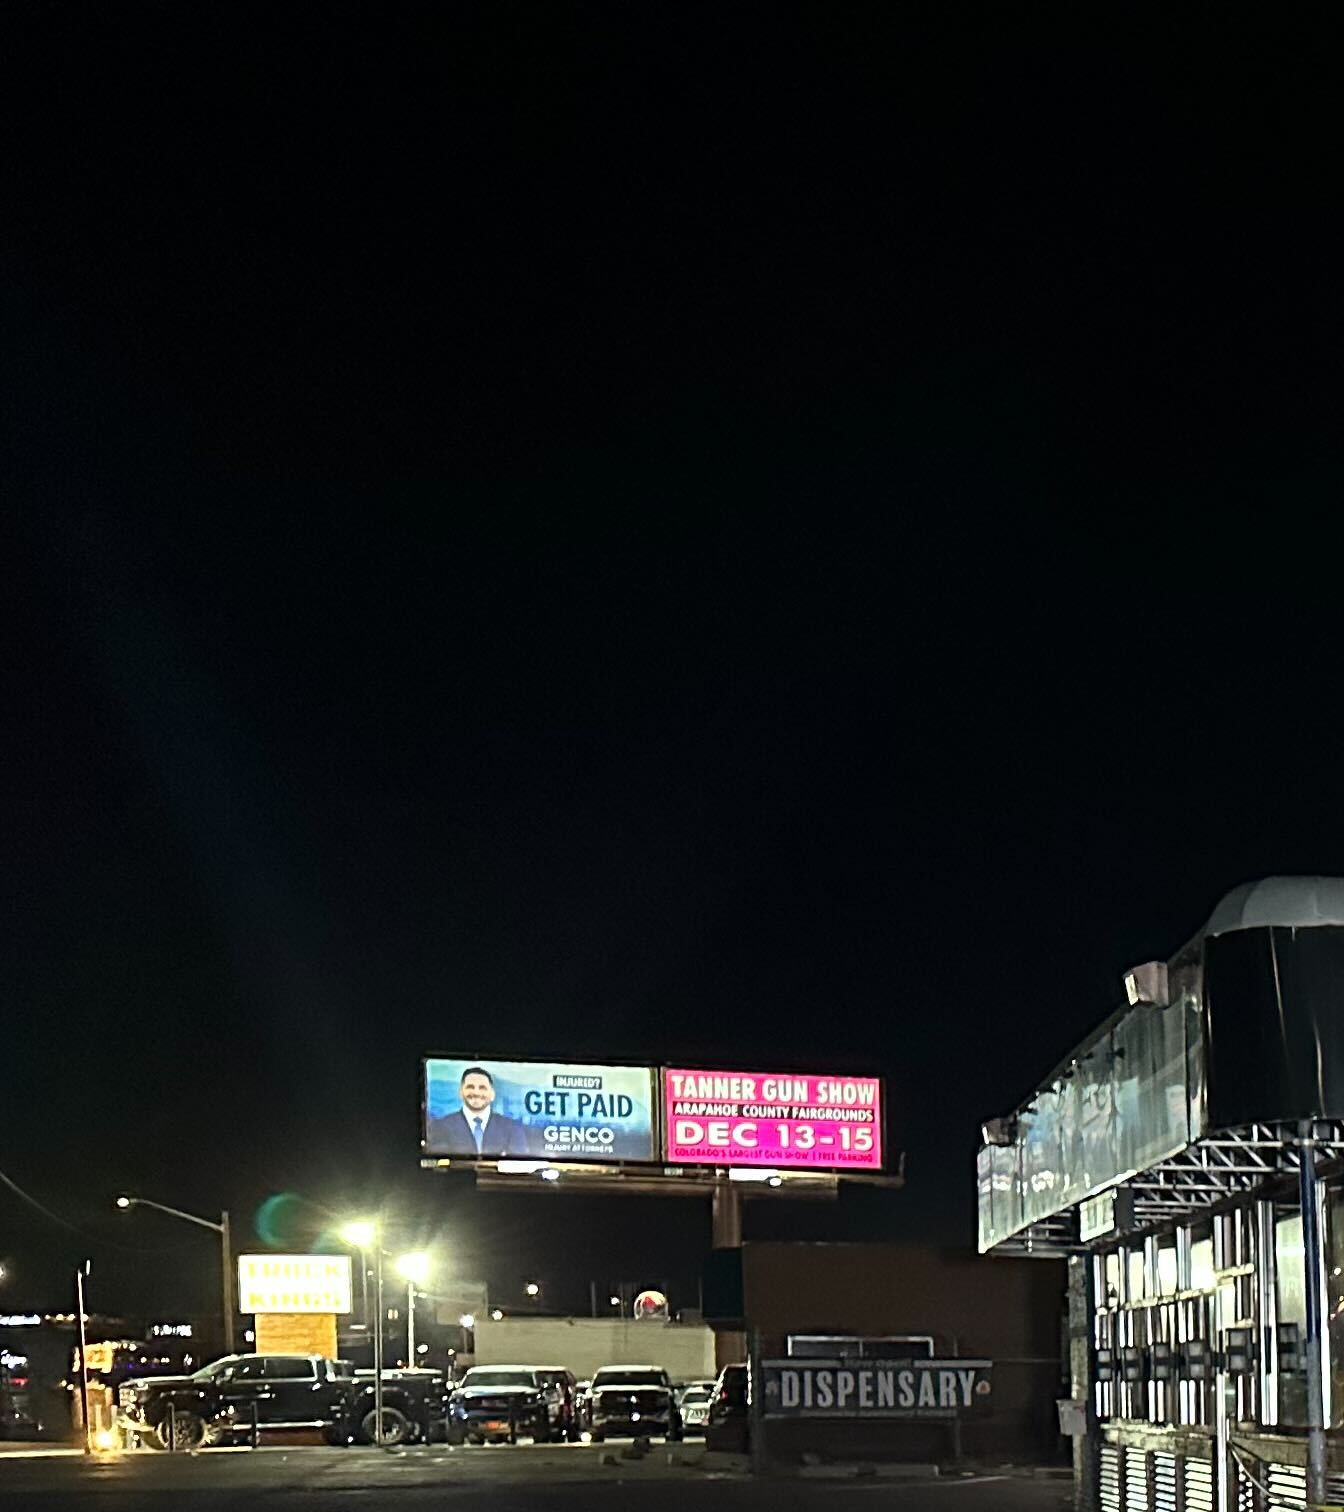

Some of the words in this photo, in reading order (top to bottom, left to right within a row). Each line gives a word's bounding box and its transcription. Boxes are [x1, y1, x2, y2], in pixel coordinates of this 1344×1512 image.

[671, 1075, 757, 1101] TANNER
[763, 1079, 808, 1103] GUN
[817, 1082, 875, 1105] SHOW
[525, 1091, 569, 1117] GET
[578, 1093, 633, 1118] PAID
[675, 1103, 738, 1116] ARAPAHOE
[743, 1106, 788, 1119] COUNTY
[792, 1108, 873, 1122] FAIRGROUNDS
[544, 1126, 614, 1144] GENCO
[675, 1121, 758, 1147] DEC
[776, 1124, 873, 1151] 13-15
[781, 1371, 976, 1408] DISPENSARY
